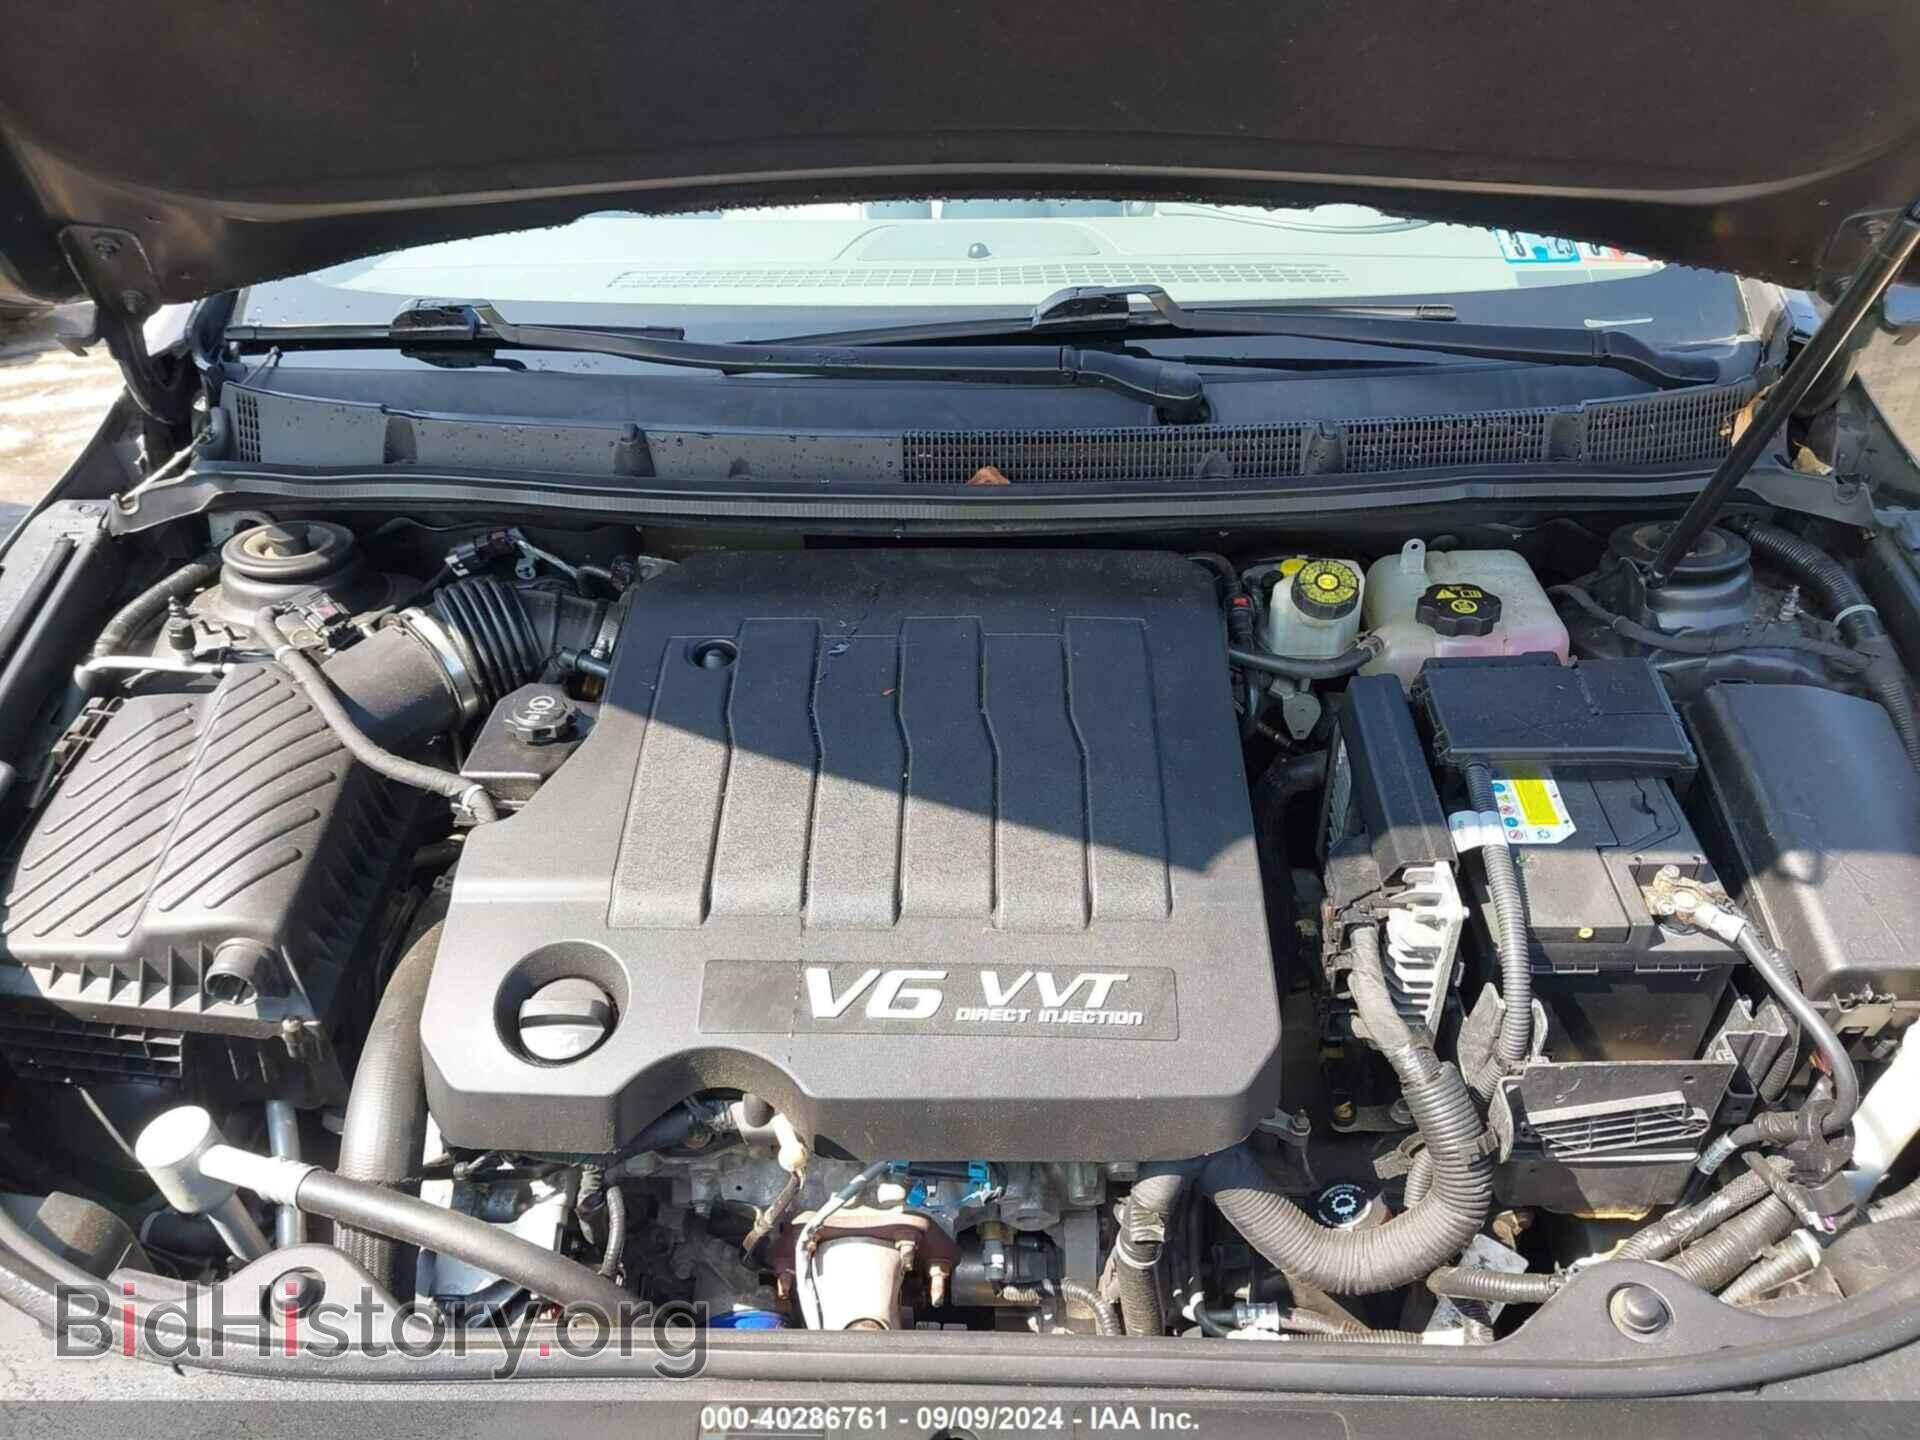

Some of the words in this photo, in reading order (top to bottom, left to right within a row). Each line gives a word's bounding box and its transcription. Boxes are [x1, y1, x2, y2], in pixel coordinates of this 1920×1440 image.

[805, 967, 949, 1020] V6
[980, 970, 1128, 1009] VVT
[955, 1007, 1029, 1024] DIRECT
[1037, 1010, 1144, 1026] INJECTION
